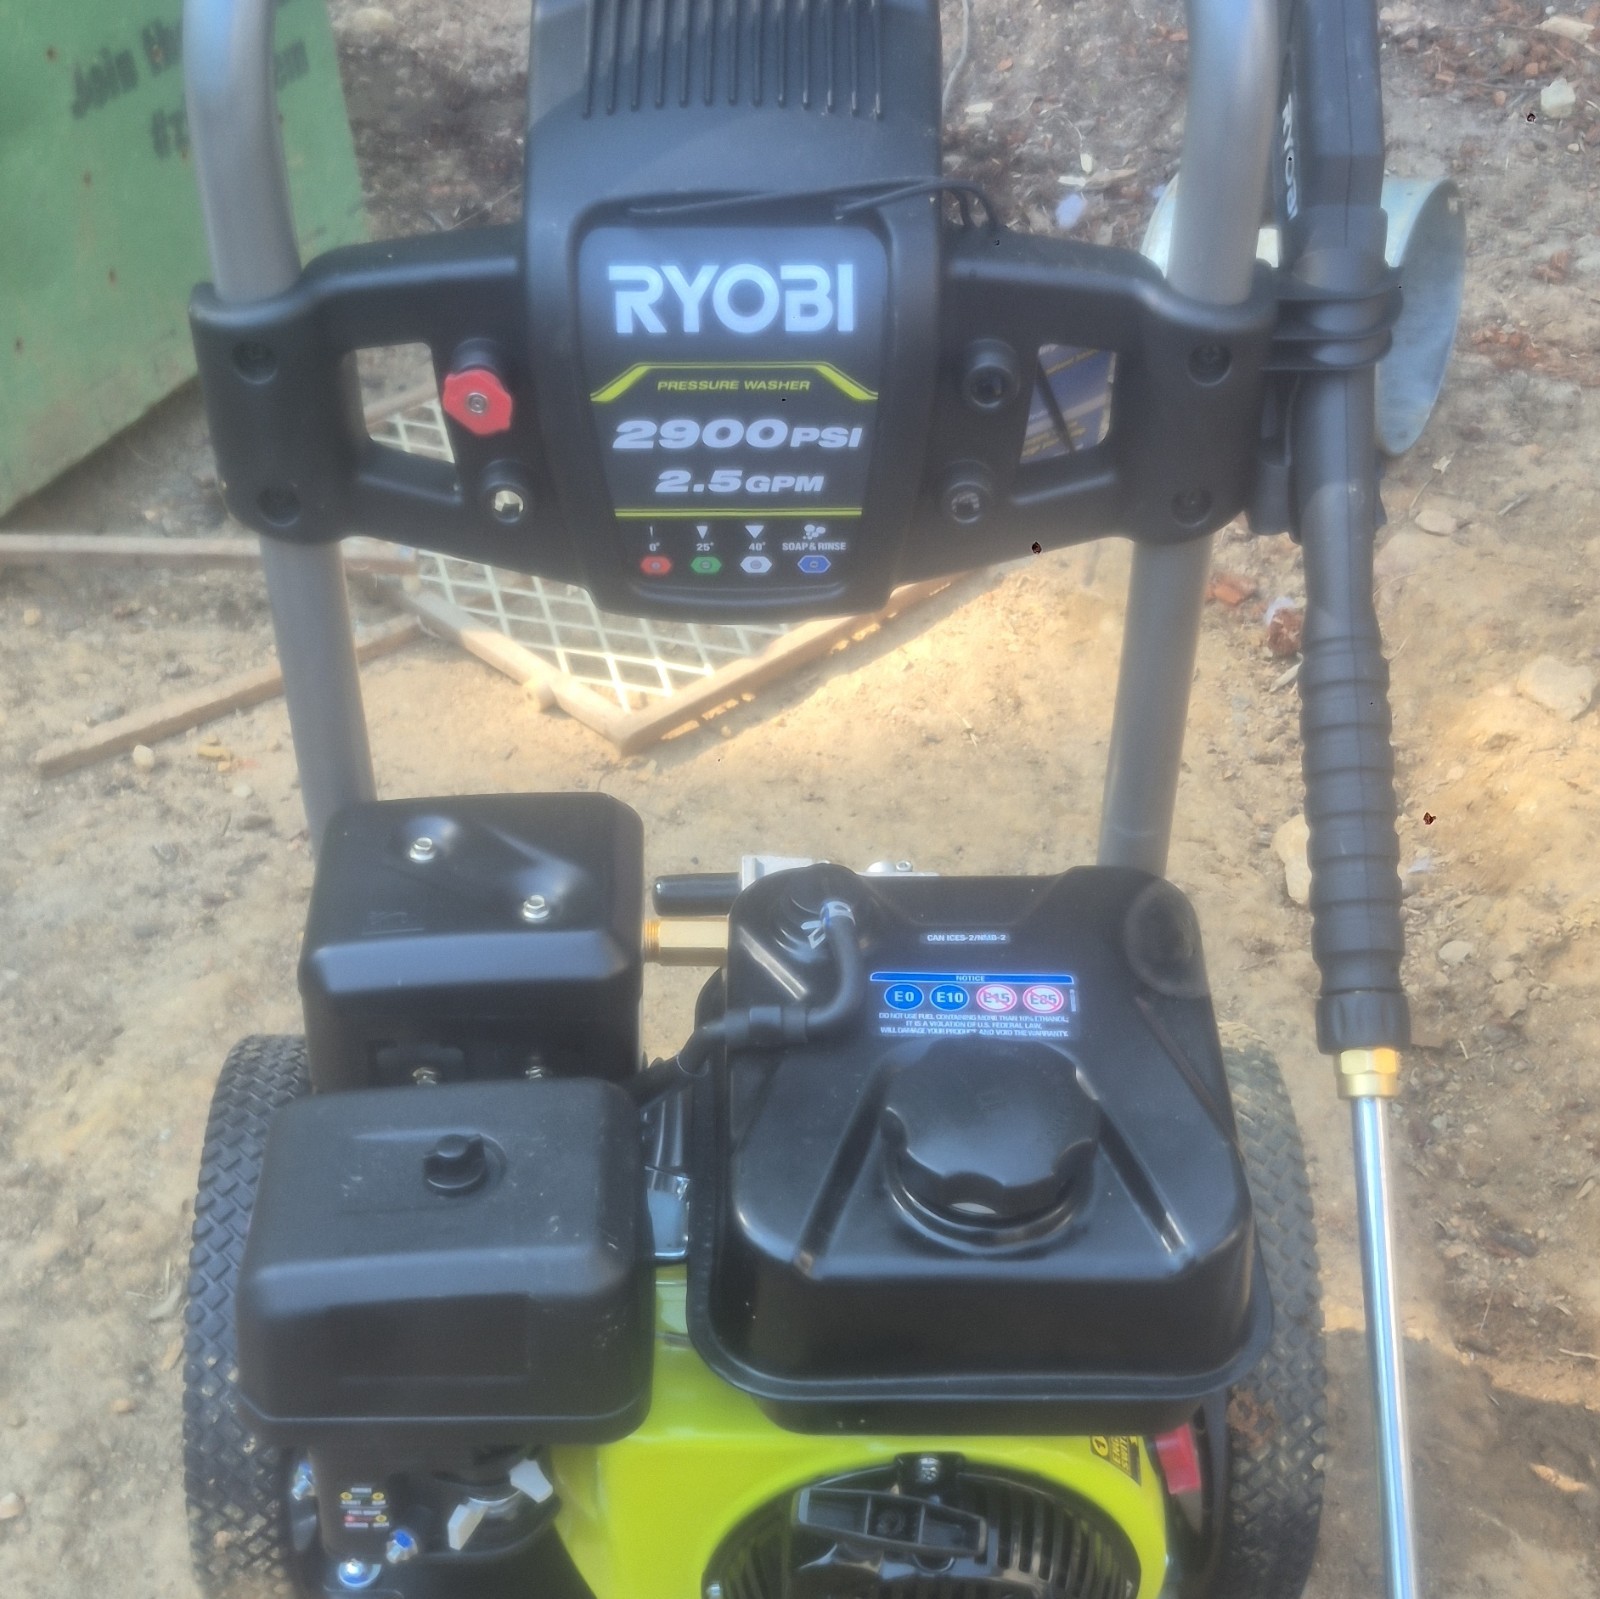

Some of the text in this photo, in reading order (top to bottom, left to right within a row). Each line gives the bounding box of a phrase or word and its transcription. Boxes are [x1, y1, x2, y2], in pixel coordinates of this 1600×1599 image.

[608, 263, 854, 334] RYOBI
[657, 380, 811, 391] PRESSURE WASHER
[782, 542, 808, 551] SOAP
[818, 542, 847, 551] RINSE
[927, 934, 944, 942] CAN
[955, 975, 985, 983] NOTICE
[894, 991, 915, 1002] E0
[936, 992, 964, 1003] E10
